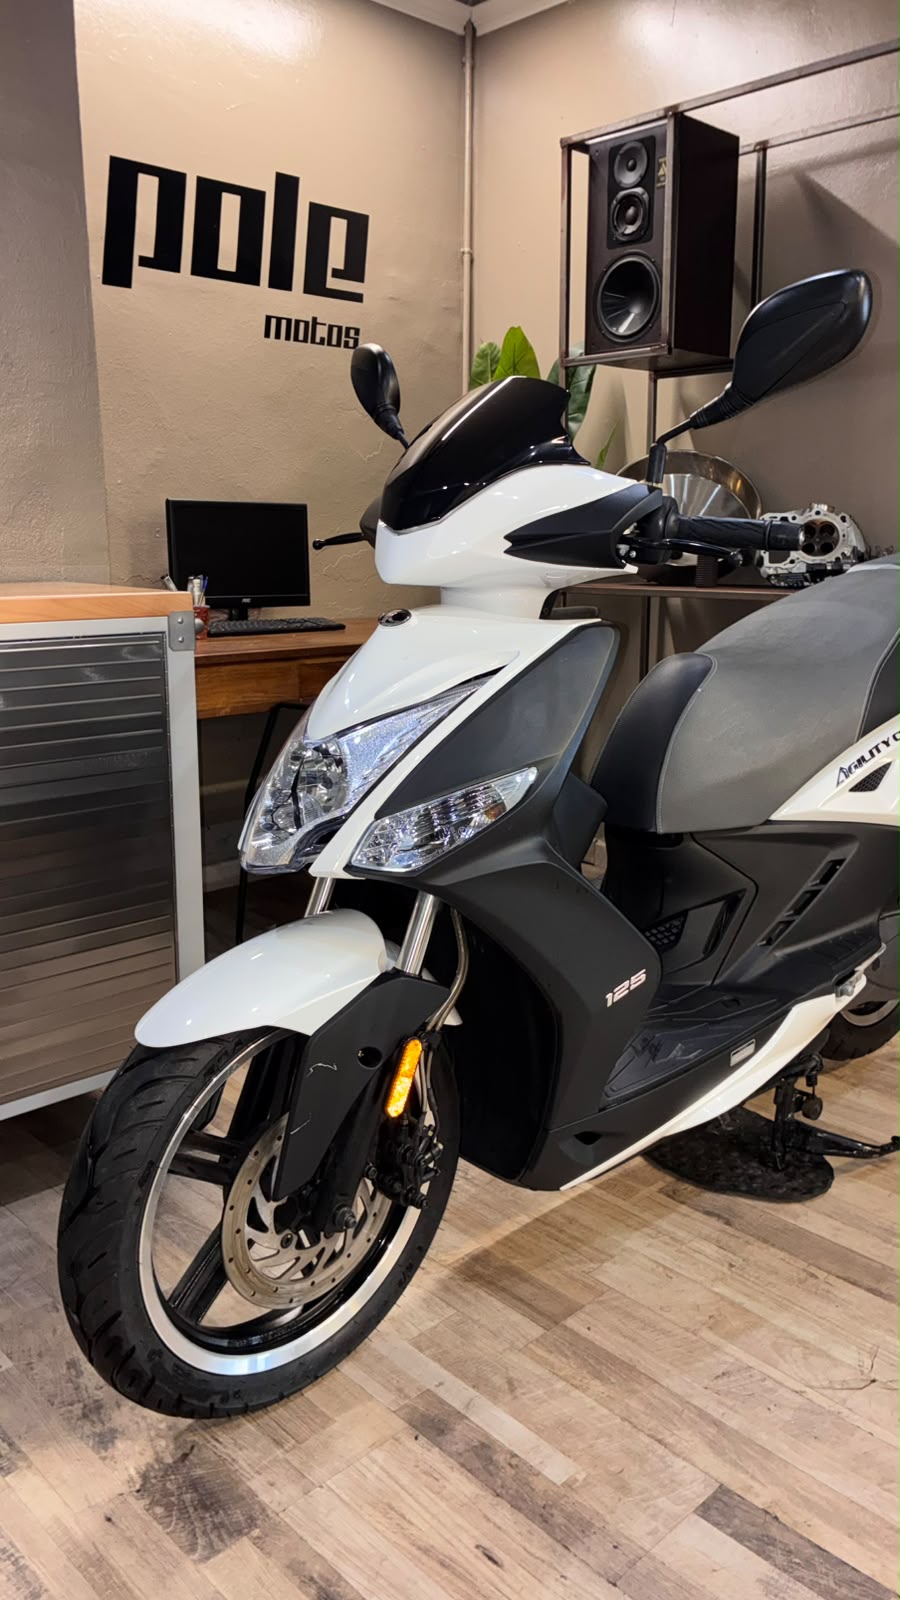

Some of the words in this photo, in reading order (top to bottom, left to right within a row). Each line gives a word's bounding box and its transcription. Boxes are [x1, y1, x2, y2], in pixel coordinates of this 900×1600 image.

[102, 155, 370, 304] pole
[264, 314, 360, 350] motos
[836, 736, 891, 788] AGILITY
[605, 968, 647, 1008] 125
